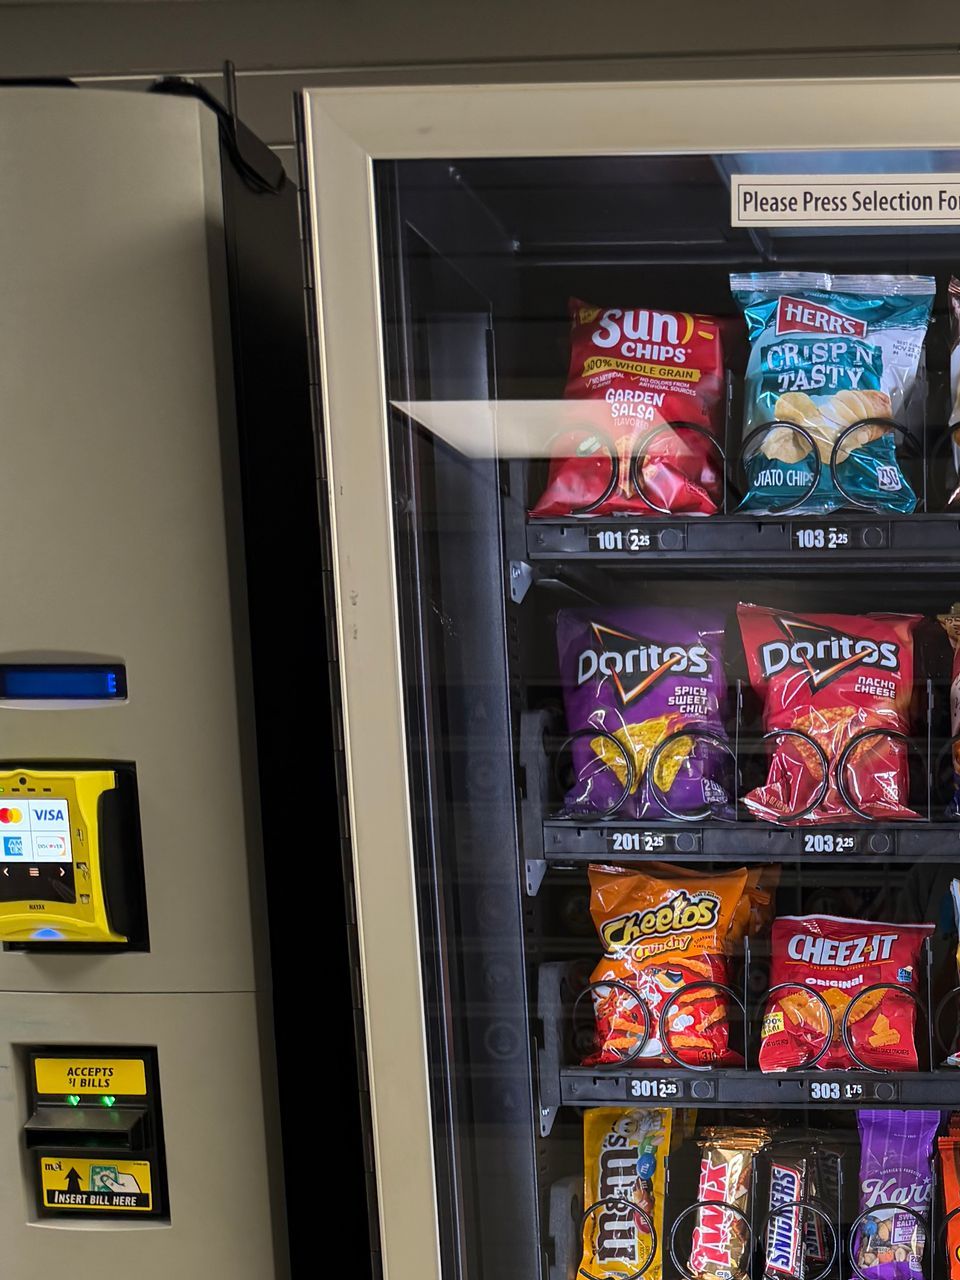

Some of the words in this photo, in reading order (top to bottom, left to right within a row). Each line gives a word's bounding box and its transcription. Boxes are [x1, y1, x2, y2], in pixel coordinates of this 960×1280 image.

[743, 191, 797, 212] Please
[803, 191, 847, 211] Press
[852, 191, 932, 211] Selection
[786, 303, 857, 335] HERR'S
[592, 309, 679, 348] Sun
[621, 342, 686, 363] CHIPS
[616, 361, 656, 375] WHOLE
[659, 368, 693, 379] GRAIN
[778, 365, 865, 392] TASTY
[606, 389, 665, 407] GARDEN
[611, 403, 654, 421] SALSA
[596, 531, 623, 550] 101
[796, 529, 824, 548] 103
[577, 645, 708, 685] Doritos
[763, 637, 898, 676] Doritos
[674, 686, 707, 696] SPICY
[855, 683, 896, 698] CHEESE
[858, 676, 896, 690] NACHO
[668, 696, 707, 705] SWEET
[680, 705, 708, 714] CHILI
[32, 809, 64, 822] VISA
[613, 834, 639, 851] 201
[805, 835, 834, 853] 203
[603, 894, 715, 951] Cheetos
[633, 935, 691, 961] Crunchy
[67, 1067, 114, 1077] ACCEPTS
[68, 1078, 76, 1088] $1
[80, 1078, 110, 1088] BILLS
[632, 1080, 657, 1096] 301
[811, 1083, 840, 1099] 303
[54, 1191, 87, 1204] INSERT
[90, 1195, 110, 1205] BILL
[113, 1196, 137, 1206] HERE
[691, 1159, 731, 1272] TWIX
[769, 1168, 796, 1269] SNICKERS
